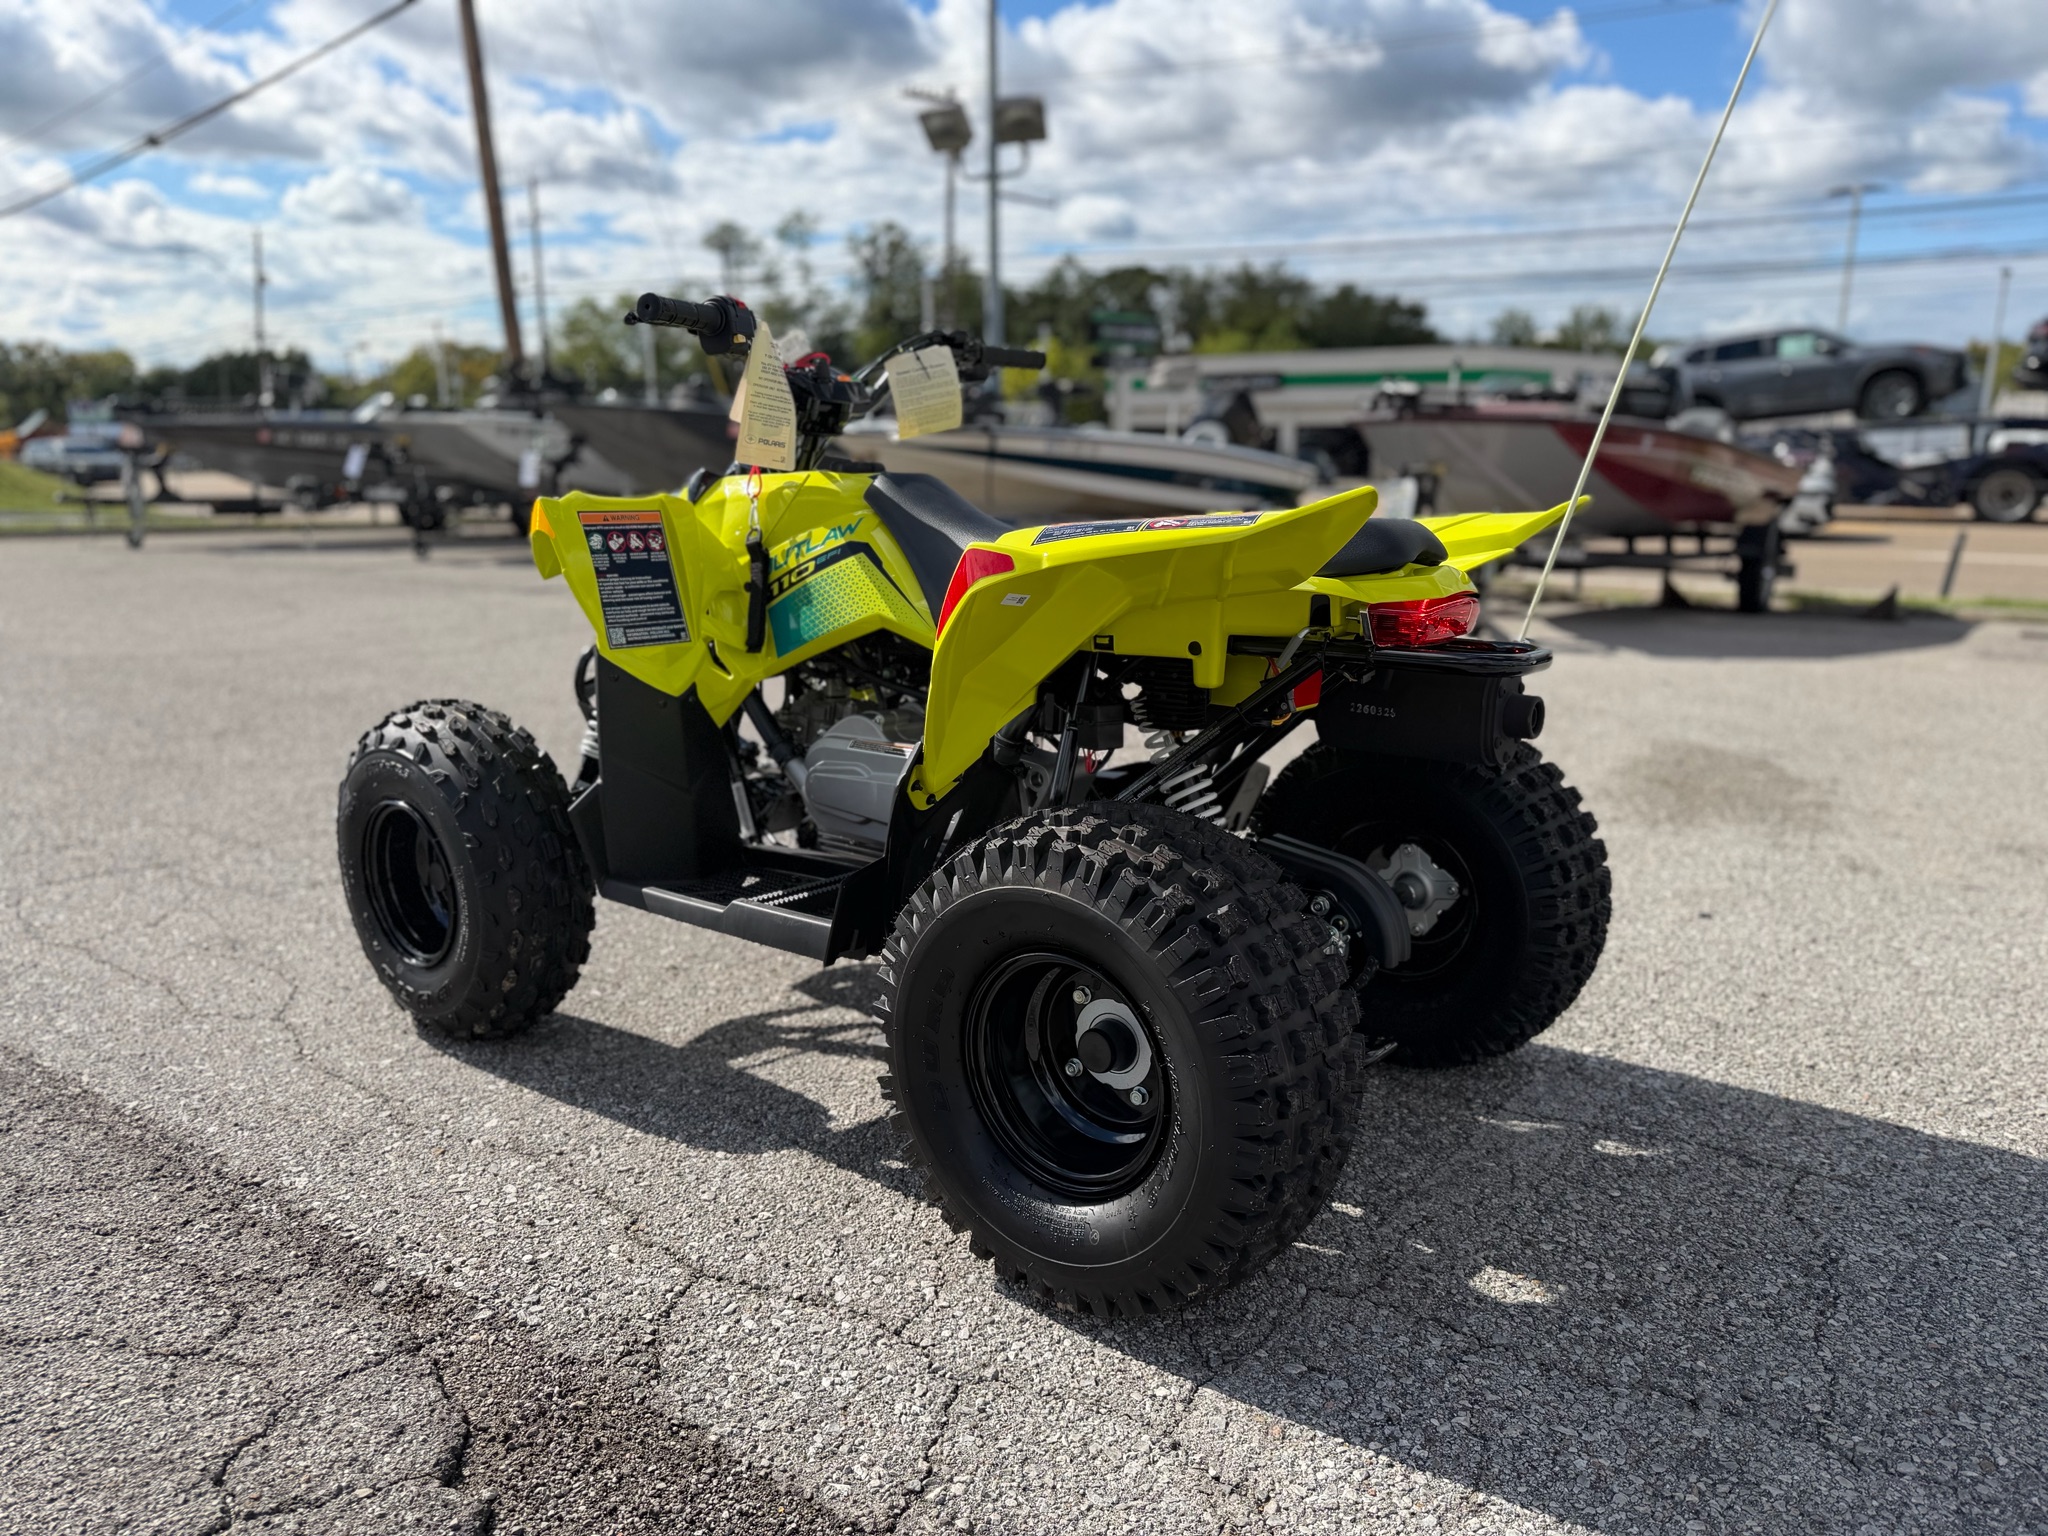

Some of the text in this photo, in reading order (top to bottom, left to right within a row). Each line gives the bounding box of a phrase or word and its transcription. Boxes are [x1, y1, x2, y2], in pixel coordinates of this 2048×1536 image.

[758, 437, 786, 449] POLARIS
[768, 516, 865, 574] UTLAW
[770, 548, 841, 596] 110 EFI
[1128, 784, 1154, 804] OLARIS
